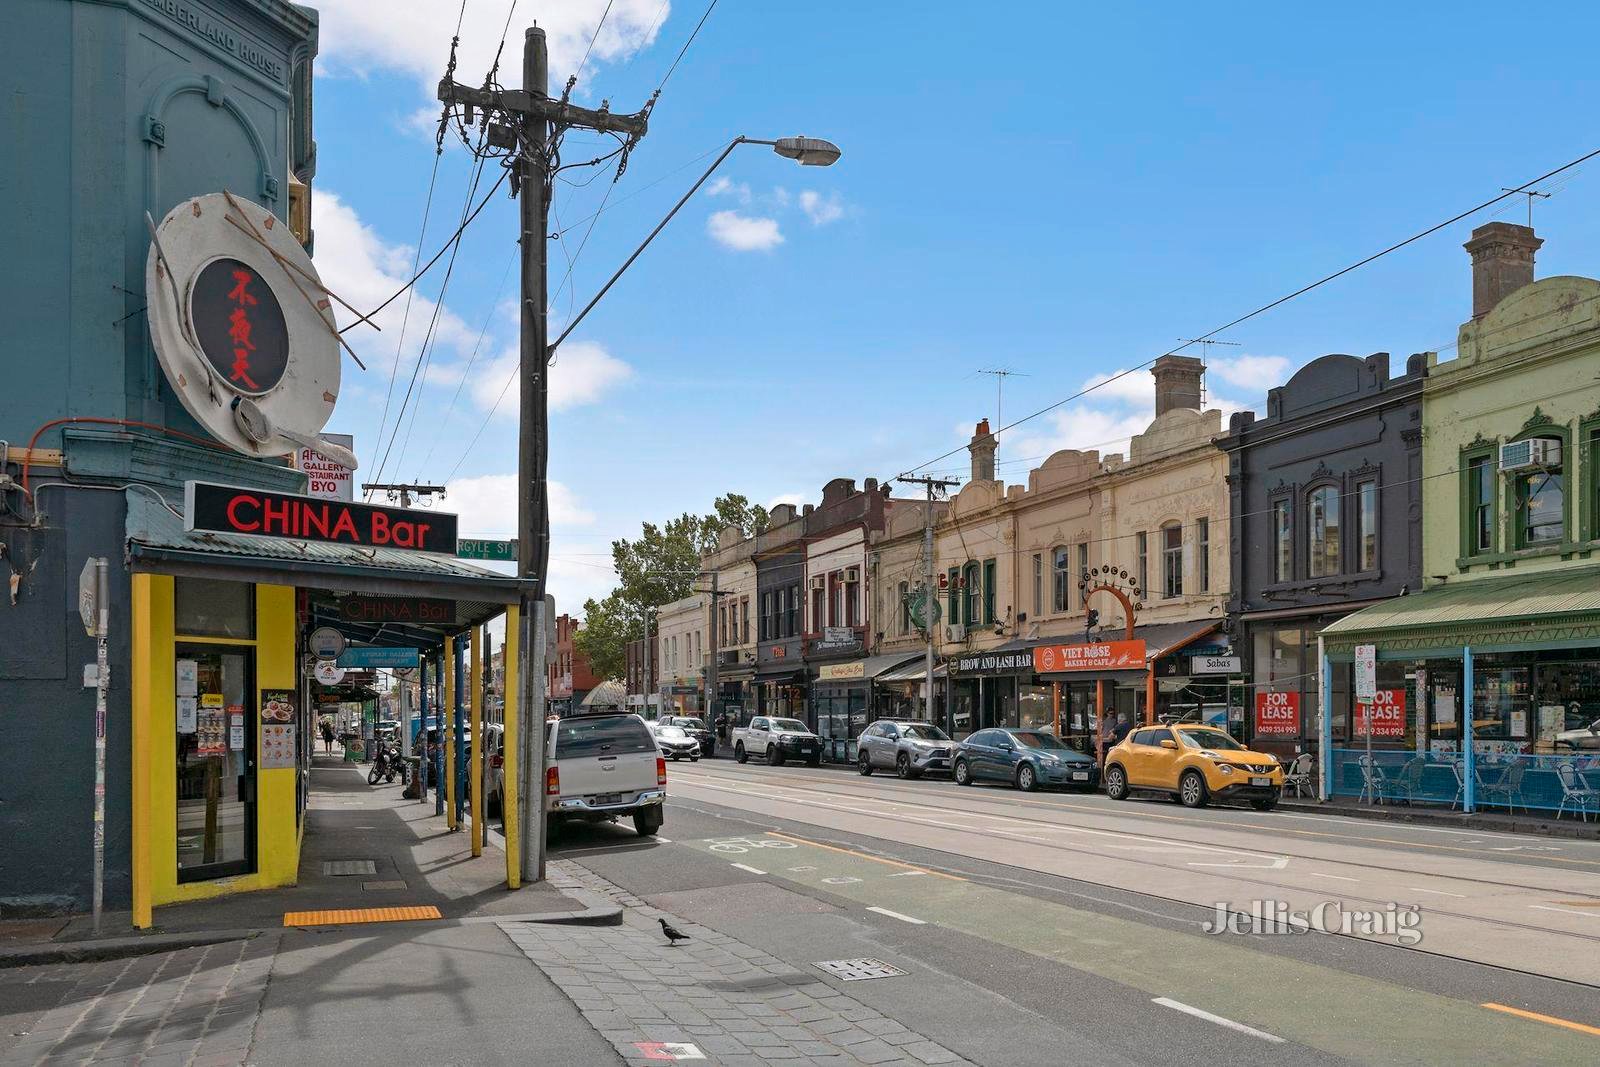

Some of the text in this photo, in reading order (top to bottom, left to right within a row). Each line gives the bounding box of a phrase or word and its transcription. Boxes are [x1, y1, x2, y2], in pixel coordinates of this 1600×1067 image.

[239, 42, 282, 80] HOUSE
[303, 461, 344, 473] GALLERY
[307, 471, 350, 481] STAURANT
[226, 494, 431, 549] CHINA Bar
[458, 540, 510, 554] RGYLE ST
[345, 599, 448, 619] CHINA Bar
[1062, 645, 1111, 659] VIET ROSE
[960, 658, 980, 671] BROW
[981, 656, 995, 670] AND
[996, 655, 1014, 668] LASH
[1016, 654, 1032, 667] BAR
[1064, 659, 1088, 668] BAKERY
[1206, 658, 1231, 668] Saba's
[1266, 692, 1287, 705] FOR
[1374, 690, 1394, 705] OR
[1262, 706, 1294, 719] LEASE
[1362, 706, 1400, 719] LEASE
[1258, 725, 1297, 734] 0439 334 993
[1358, 726, 1404, 735] 049 334 993
